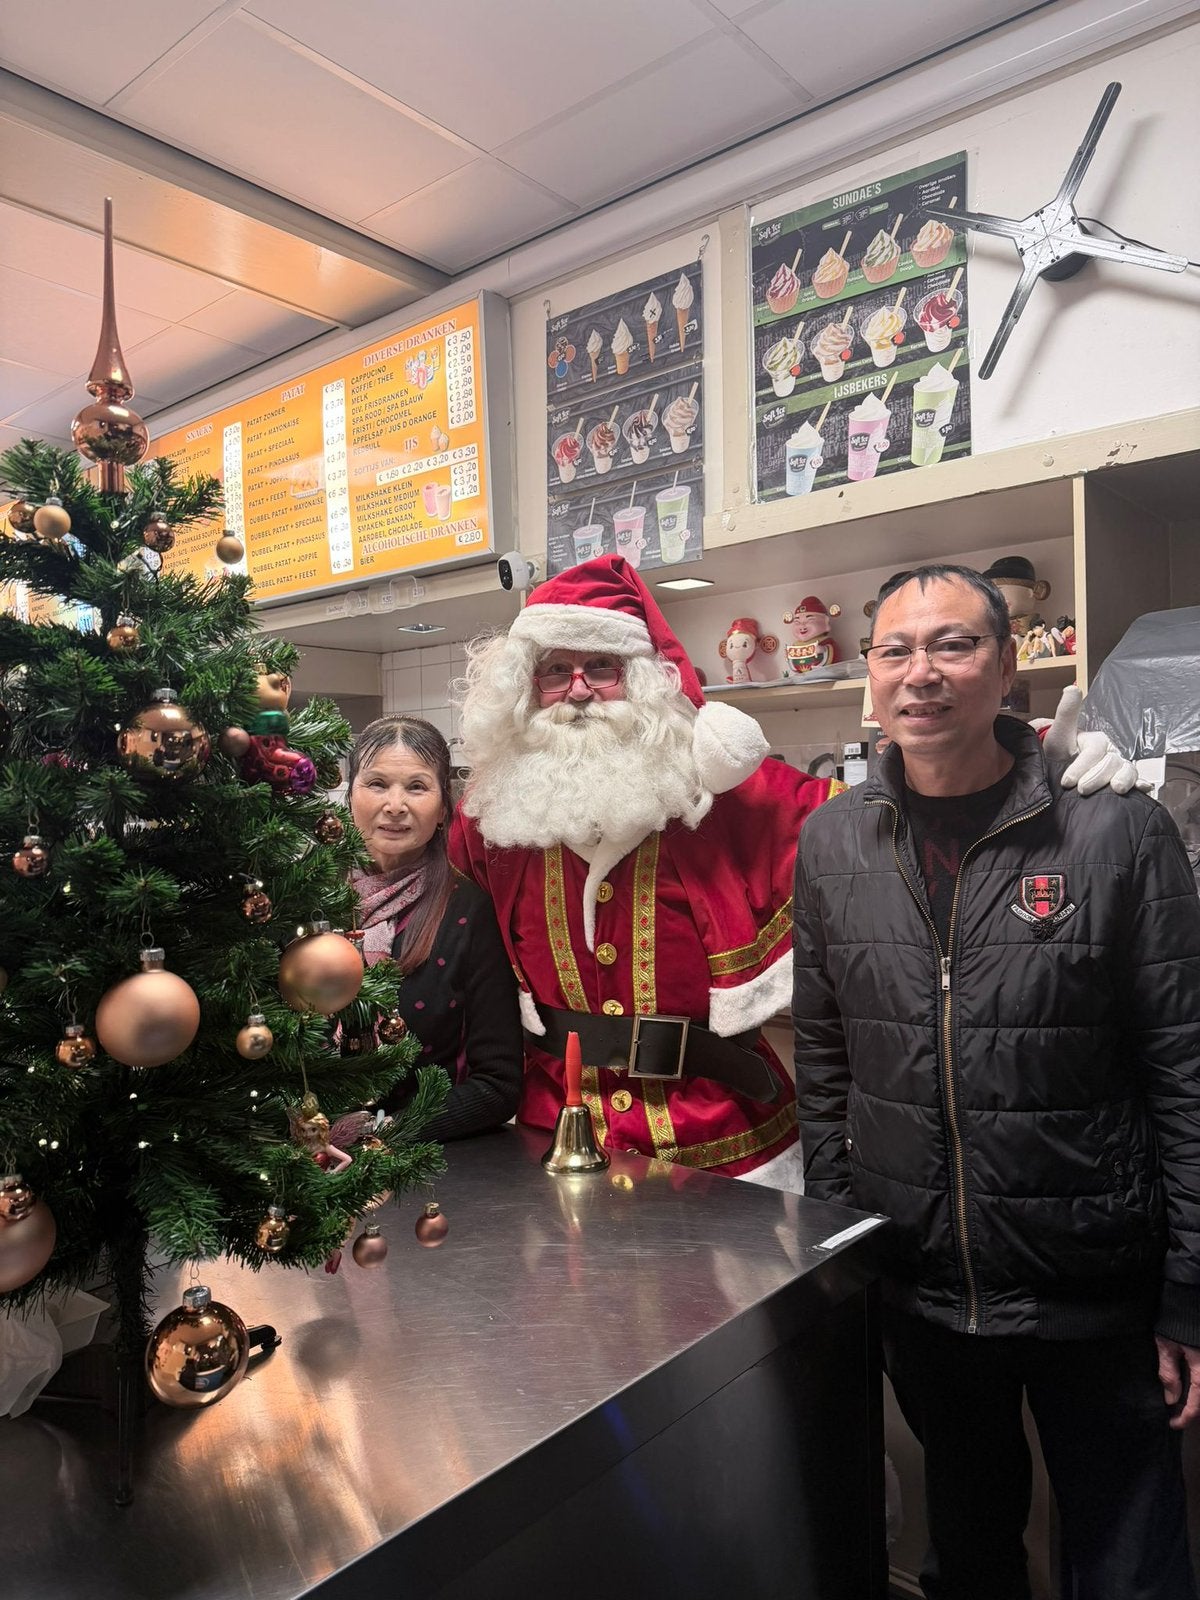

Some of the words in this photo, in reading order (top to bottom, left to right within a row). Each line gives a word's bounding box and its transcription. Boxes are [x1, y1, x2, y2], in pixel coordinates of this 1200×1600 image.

[832, 182, 882, 209] SUNDAE'S
[364, 341, 405, 367] DIVERSE
[406, 320, 456, 350] DRANKEN
[351, 365, 387, 385] CAPPUCINO
[352, 382, 374, 396] KOFFIE
[378, 372, 394, 384] THEE
[833, 374, 888, 398] IJSBEKERS
[282, 384, 305, 402] PATAT
[352, 393, 369, 405] MELK
[364, 388, 410, 410] FRISDRANKEN
[246, 416, 262, 428] PATAT
[263, 406, 286, 421] ZONDER
[352, 416, 364, 426] SPA
[365, 410, 382, 423] ROOD
[386, 402, 400, 414] SPA
[400, 392, 424, 408] BLAUW
[762, 410, 775, 422] Soft
[246, 432, 262, 444] PATAT
[268, 418, 300, 436] MAYONAISE
[352, 423, 372, 436] FRISTI
[376, 409, 412, 428] CHOCOMEL
[352, 428, 384, 446] APPELSAP
[388, 422, 402, 434] JUS
[408, 410, 438, 426] ORANGE
[247, 449, 262, 460] PATAT
[268, 437, 295, 453] SPECIAAL
[352, 442, 382, 456] REDBULL
[404, 438, 418, 451] IJS
[248, 465, 263, 476] PATAT
[269, 452, 300, 468] PINDASAUS
[354, 462, 380, 476] SOFTIJS
[248, 482, 264, 492] PATAT
[356, 488, 392, 502] MILKSHAKE
[393, 480, 413, 493] KLEIN
[248, 498, 264, 508] PATAT
[270, 491, 287, 502] FEEST
[250, 513, 271, 525] DUBBEL
[272, 507, 288, 518] PATAT
[294, 496, 324, 512] MAYONAISE
[356, 498, 392, 512] MILKSHAKE
[394, 489, 420, 504] MEDIUM
[356, 508, 392, 522] MILKSHAKE
[394, 500, 417, 514] GROOT
[250, 530, 272, 542] DUBBEL
[272, 524, 289, 535] PATAT
[295, 516, 323, 530] SPECIAAL
[363, 532, 428, 555] ALCOHOLISCHE
[430, 518, 478, 539] DRANKEN
[252, 546, 273, 558] DUBBEL
[274, 540, 290, 551] PATAT
[296, 532, 326, 546] PINDASAUS
[252, 562, 274, 574] DUBBEL
[275, 557, 292, 568] PATAT
[298, 552, 318, 564] JOPPIE
[360, 556, 374, 566] BIER
[276, 574, 292, 585] PATAT
[298, 569, 316, 580] FEEST
